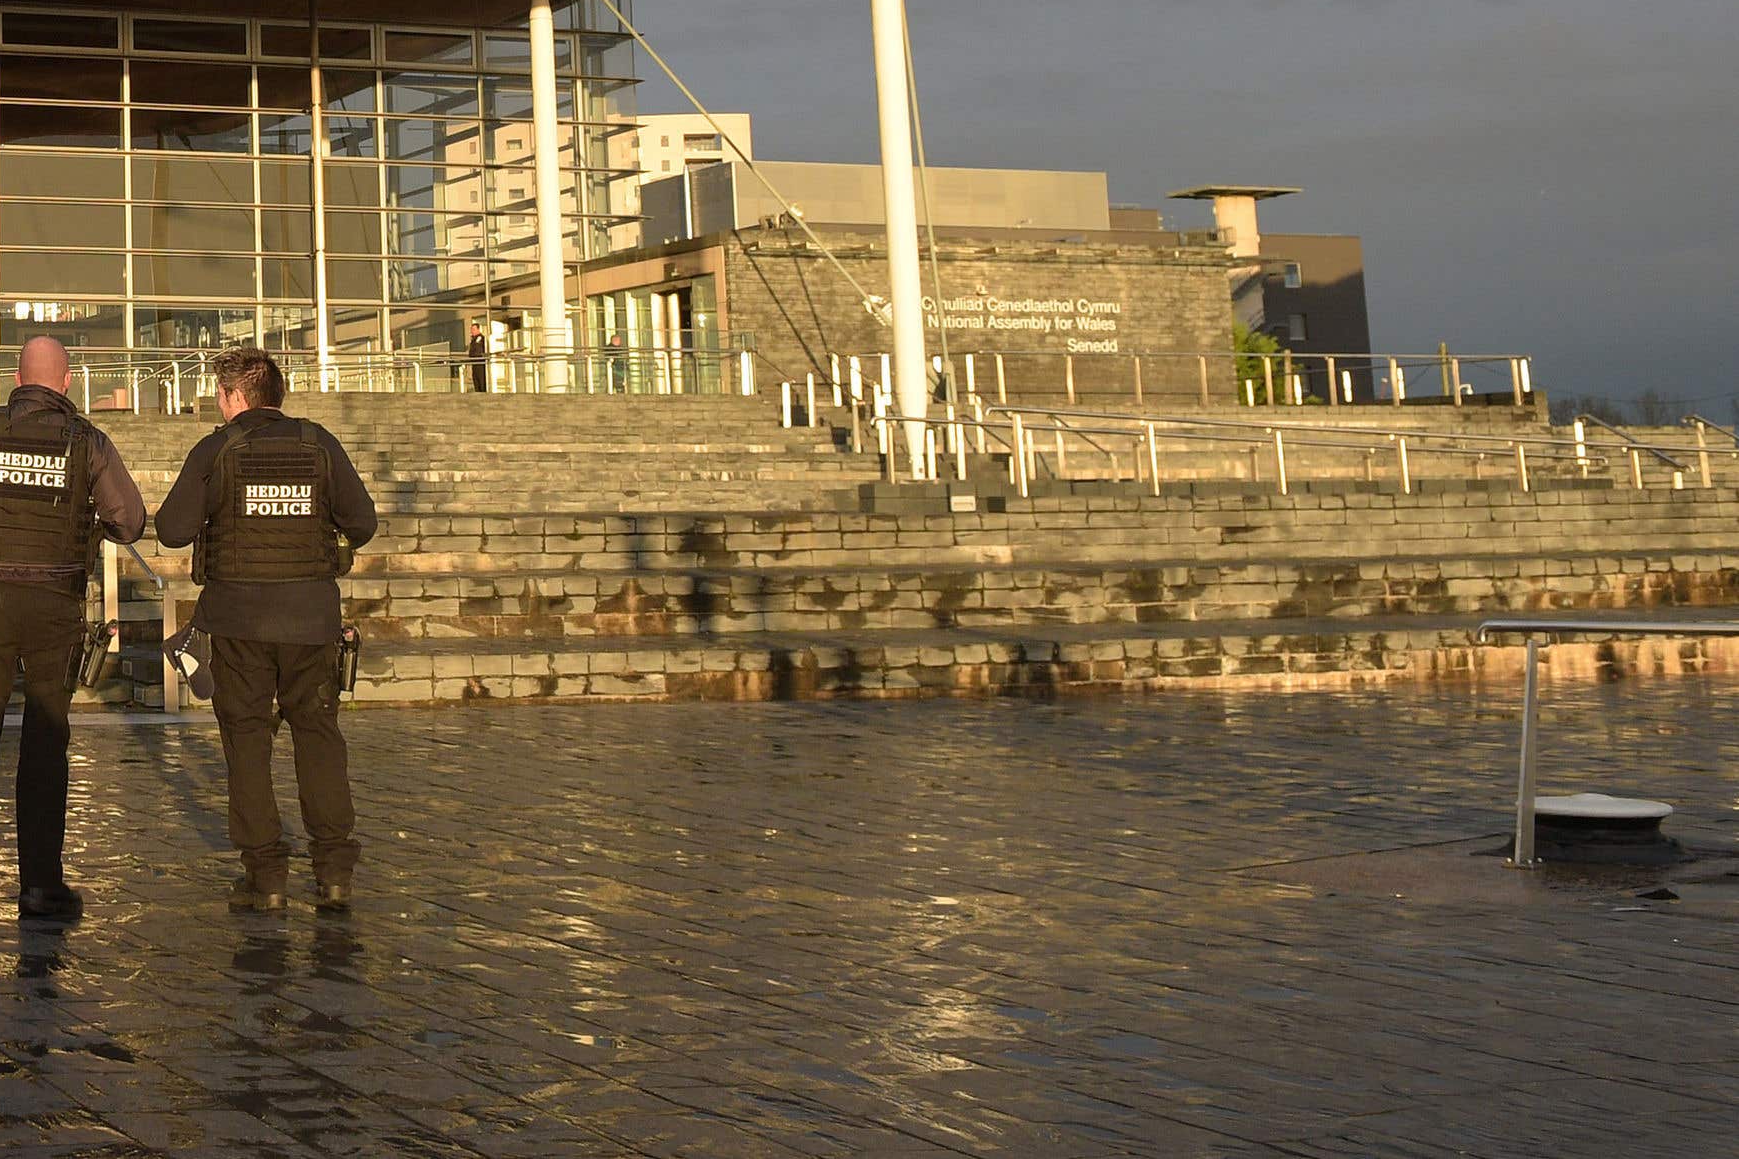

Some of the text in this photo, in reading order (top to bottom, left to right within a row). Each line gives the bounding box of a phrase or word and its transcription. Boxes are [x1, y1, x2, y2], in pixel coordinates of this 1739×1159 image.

[986, 297, 1074, 312] Cenedlaethol
[1077, 299, 1121, 316] Cymru
[987, 314, 1051, 333] Assembly
[1054, 315, 1074, 330] for
[1075, 316, 1117, 331] Wales
[1067, 338, 1118, 353] Senedd
[245, 485, 312, 498] HEDDLU
[245, 503, 312, 516] POLICE
